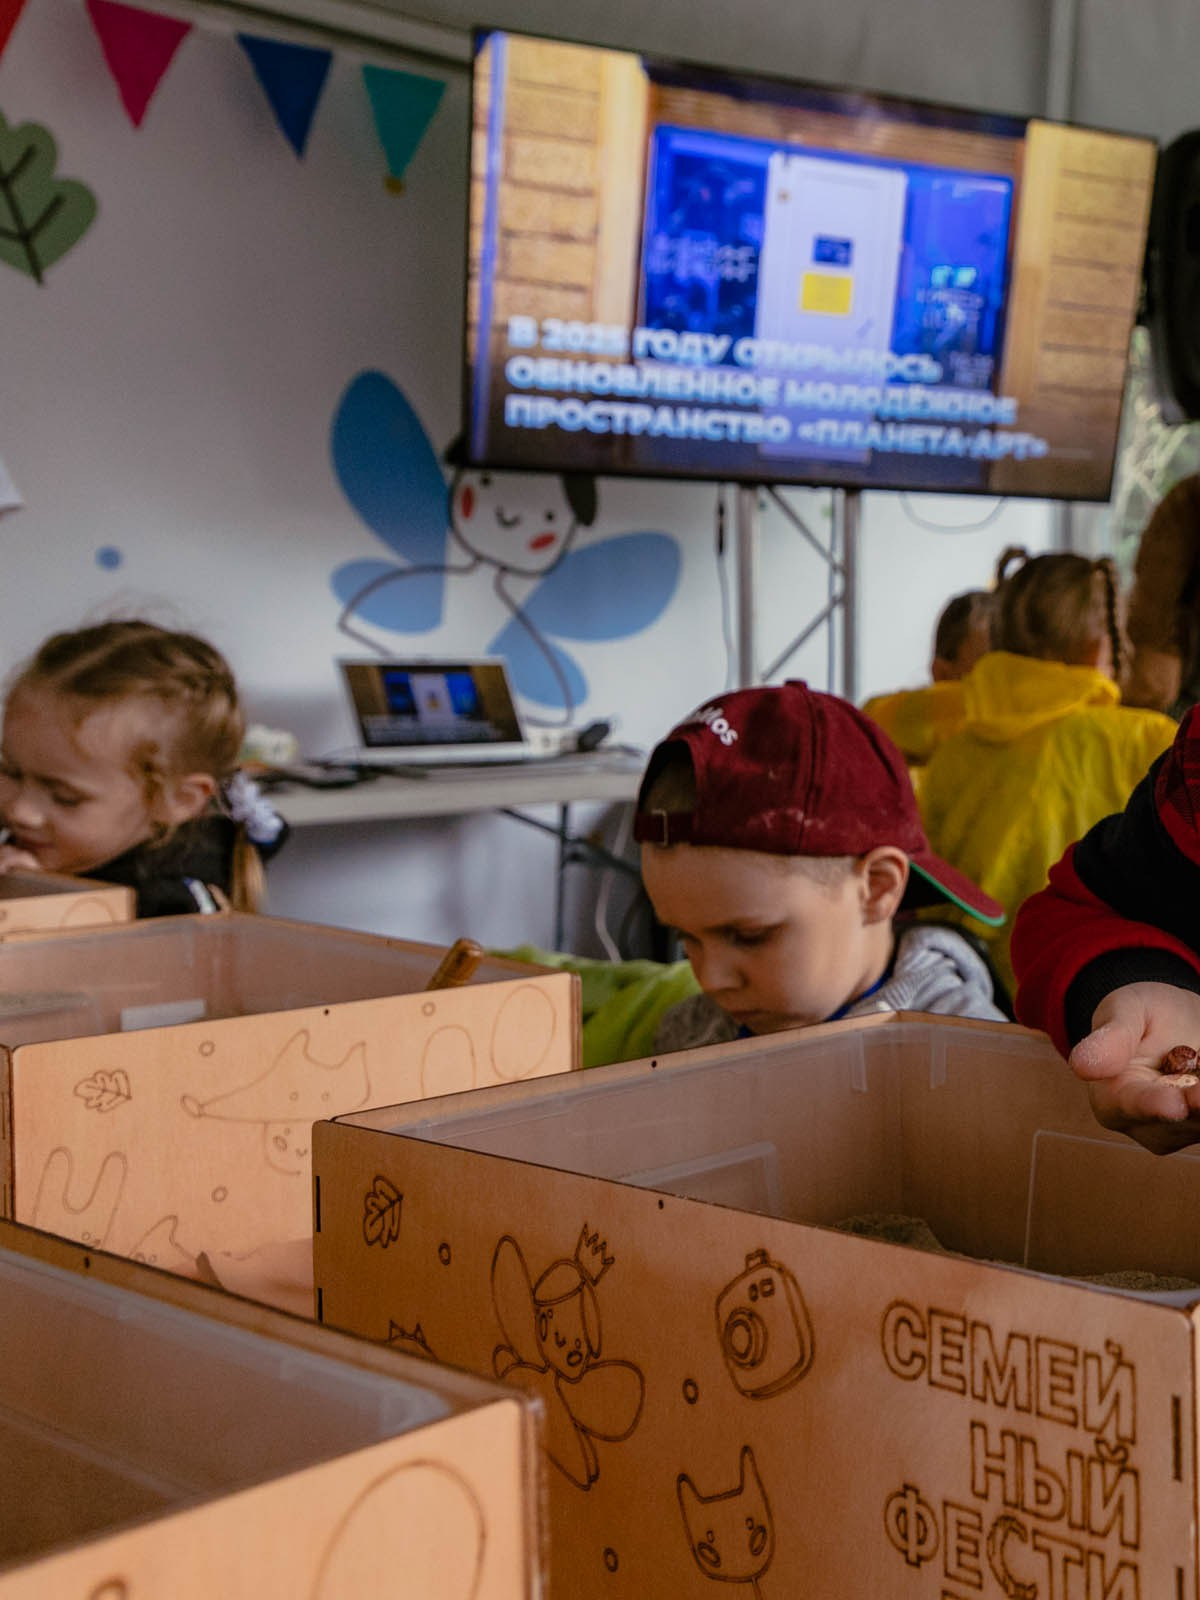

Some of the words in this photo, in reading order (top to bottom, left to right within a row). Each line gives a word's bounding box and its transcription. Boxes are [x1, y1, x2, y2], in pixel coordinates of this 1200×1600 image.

[633, 326, 733, 365] ГОДУ
[505, 394, 792, 443] ПРОСТРАНСТВО
[881, 1299, 1138, 1446] СЕМЕЙ
[884, 1483, 1141, 1600] ФЕСТИ
[970, 1419, 1141, 1552] НЫЙ
